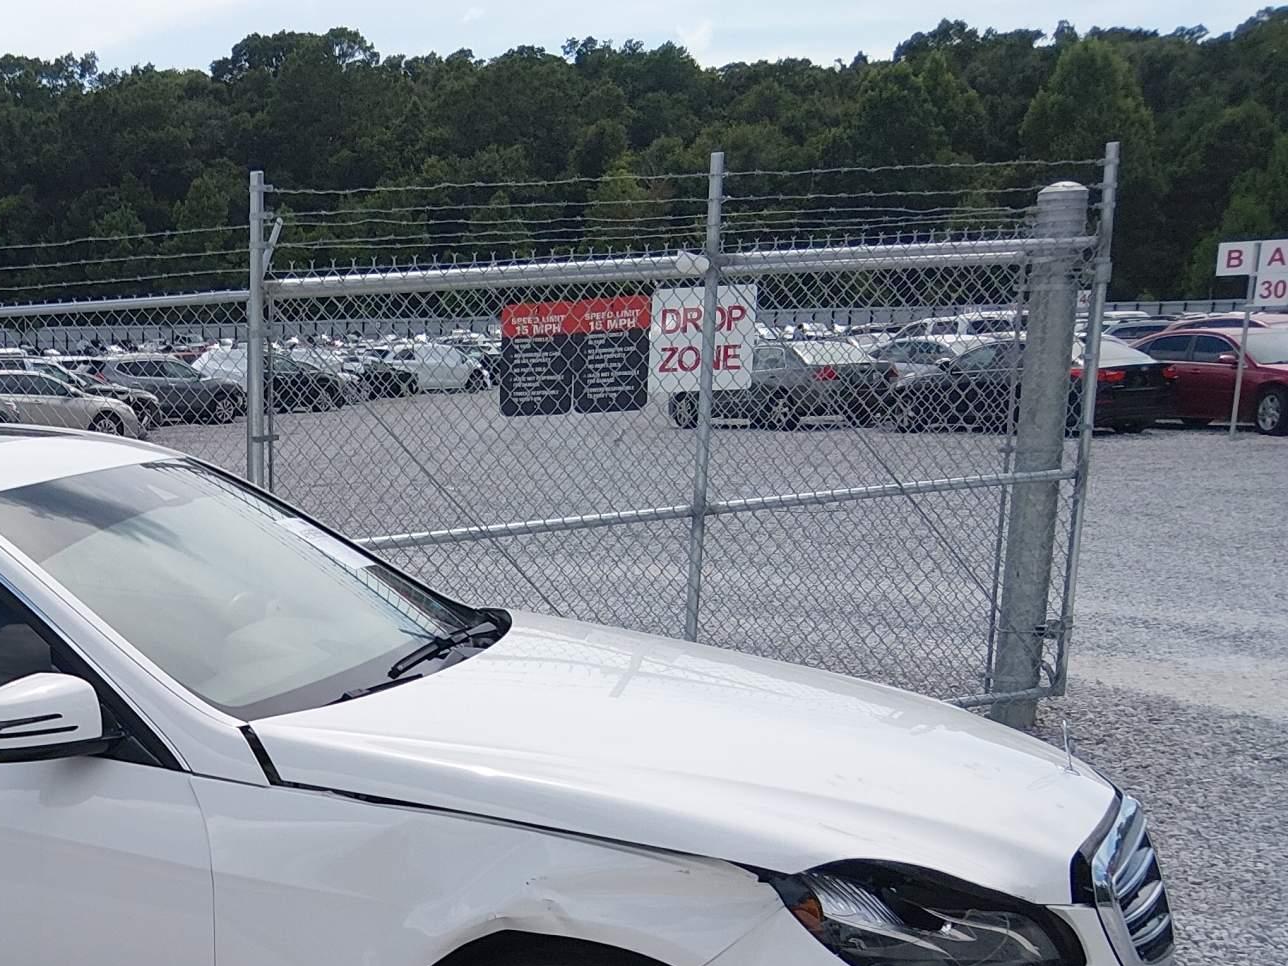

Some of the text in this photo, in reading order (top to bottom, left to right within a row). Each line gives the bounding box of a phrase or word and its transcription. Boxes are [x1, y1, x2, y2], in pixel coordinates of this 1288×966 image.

[1226, 247, 1287, 269] B A
[1259, 279, 1287, 300] 30
[515, 322, 561, 336] 15 MPH
[606, 317, 636, 330] MPH
